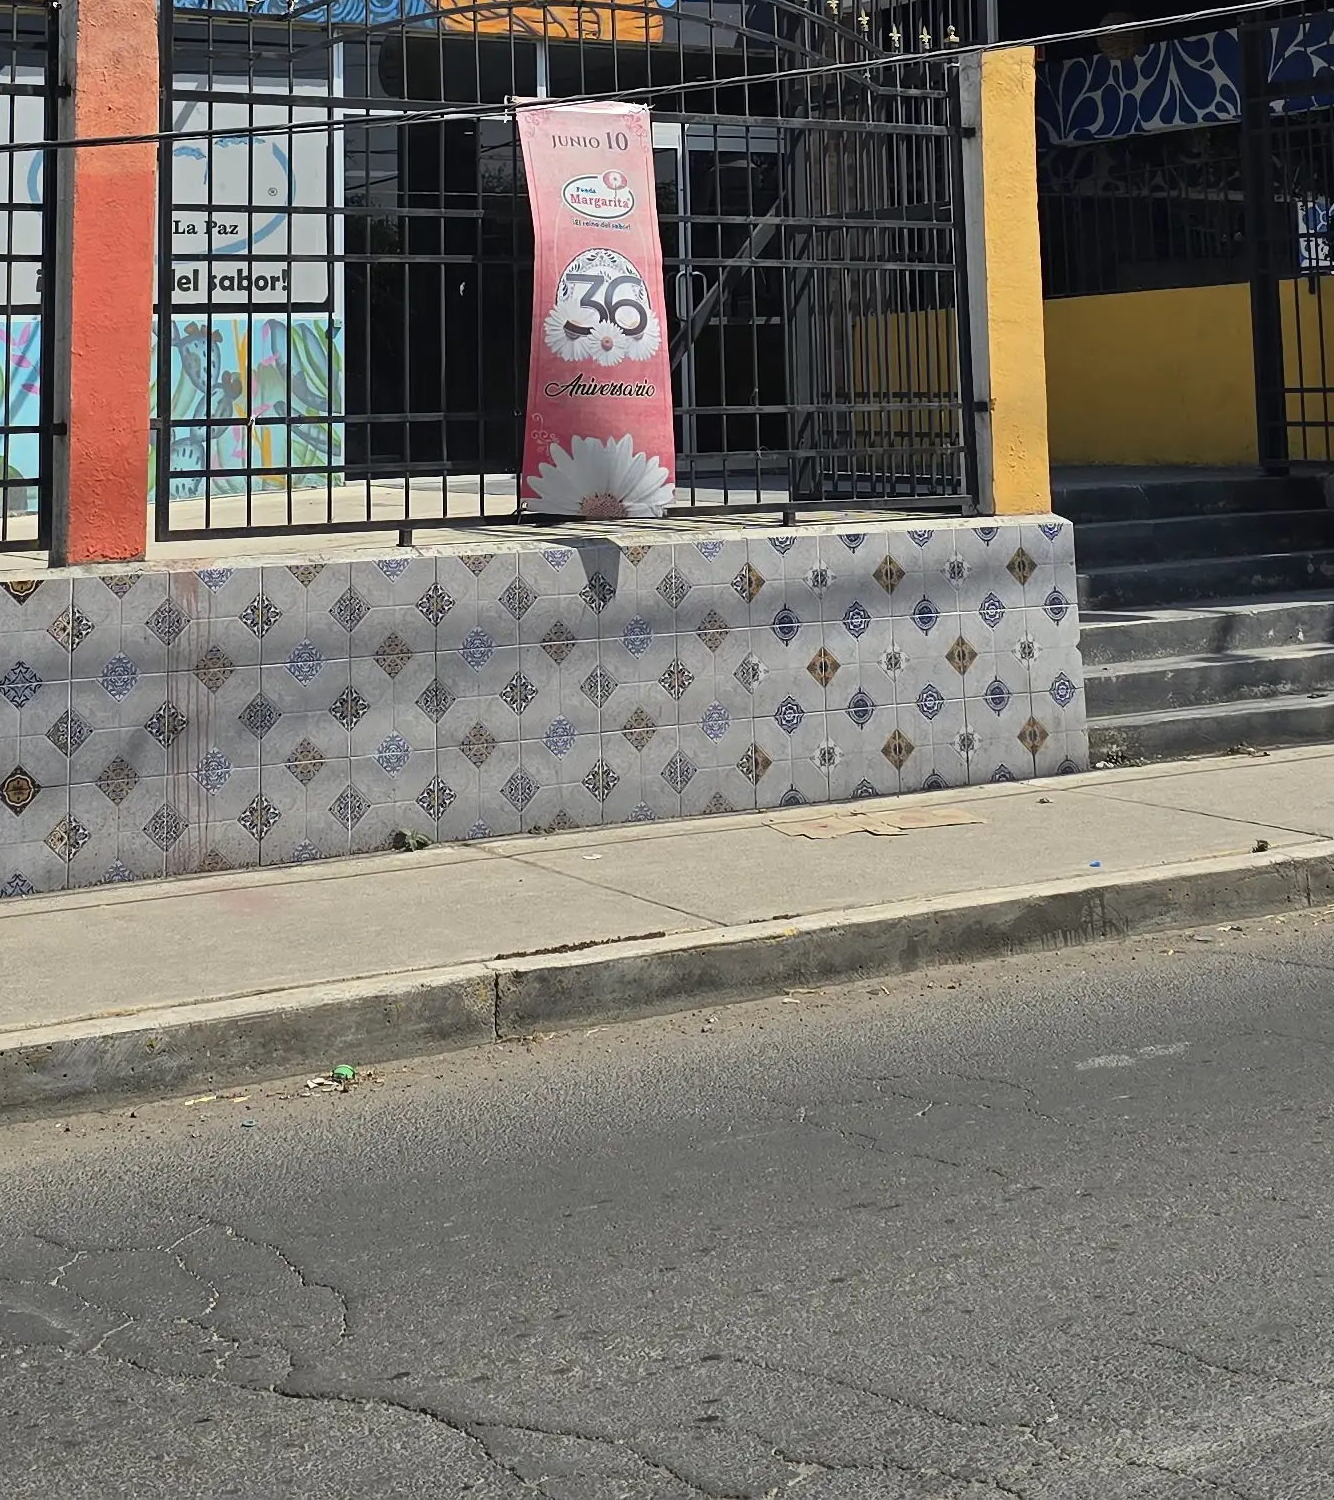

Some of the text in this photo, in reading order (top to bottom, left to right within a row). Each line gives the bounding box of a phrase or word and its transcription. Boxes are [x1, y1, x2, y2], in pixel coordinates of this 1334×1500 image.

[551, 131, 629, 151] JUNIO 10
[570, 194, 629, 209] Margarita
[172, 220, 239, 235] La Paz
[210, 268, 287, 292] sabor!
[564, 272, 648, 337] 36
[544, 373, 656, 399] Aniversario
